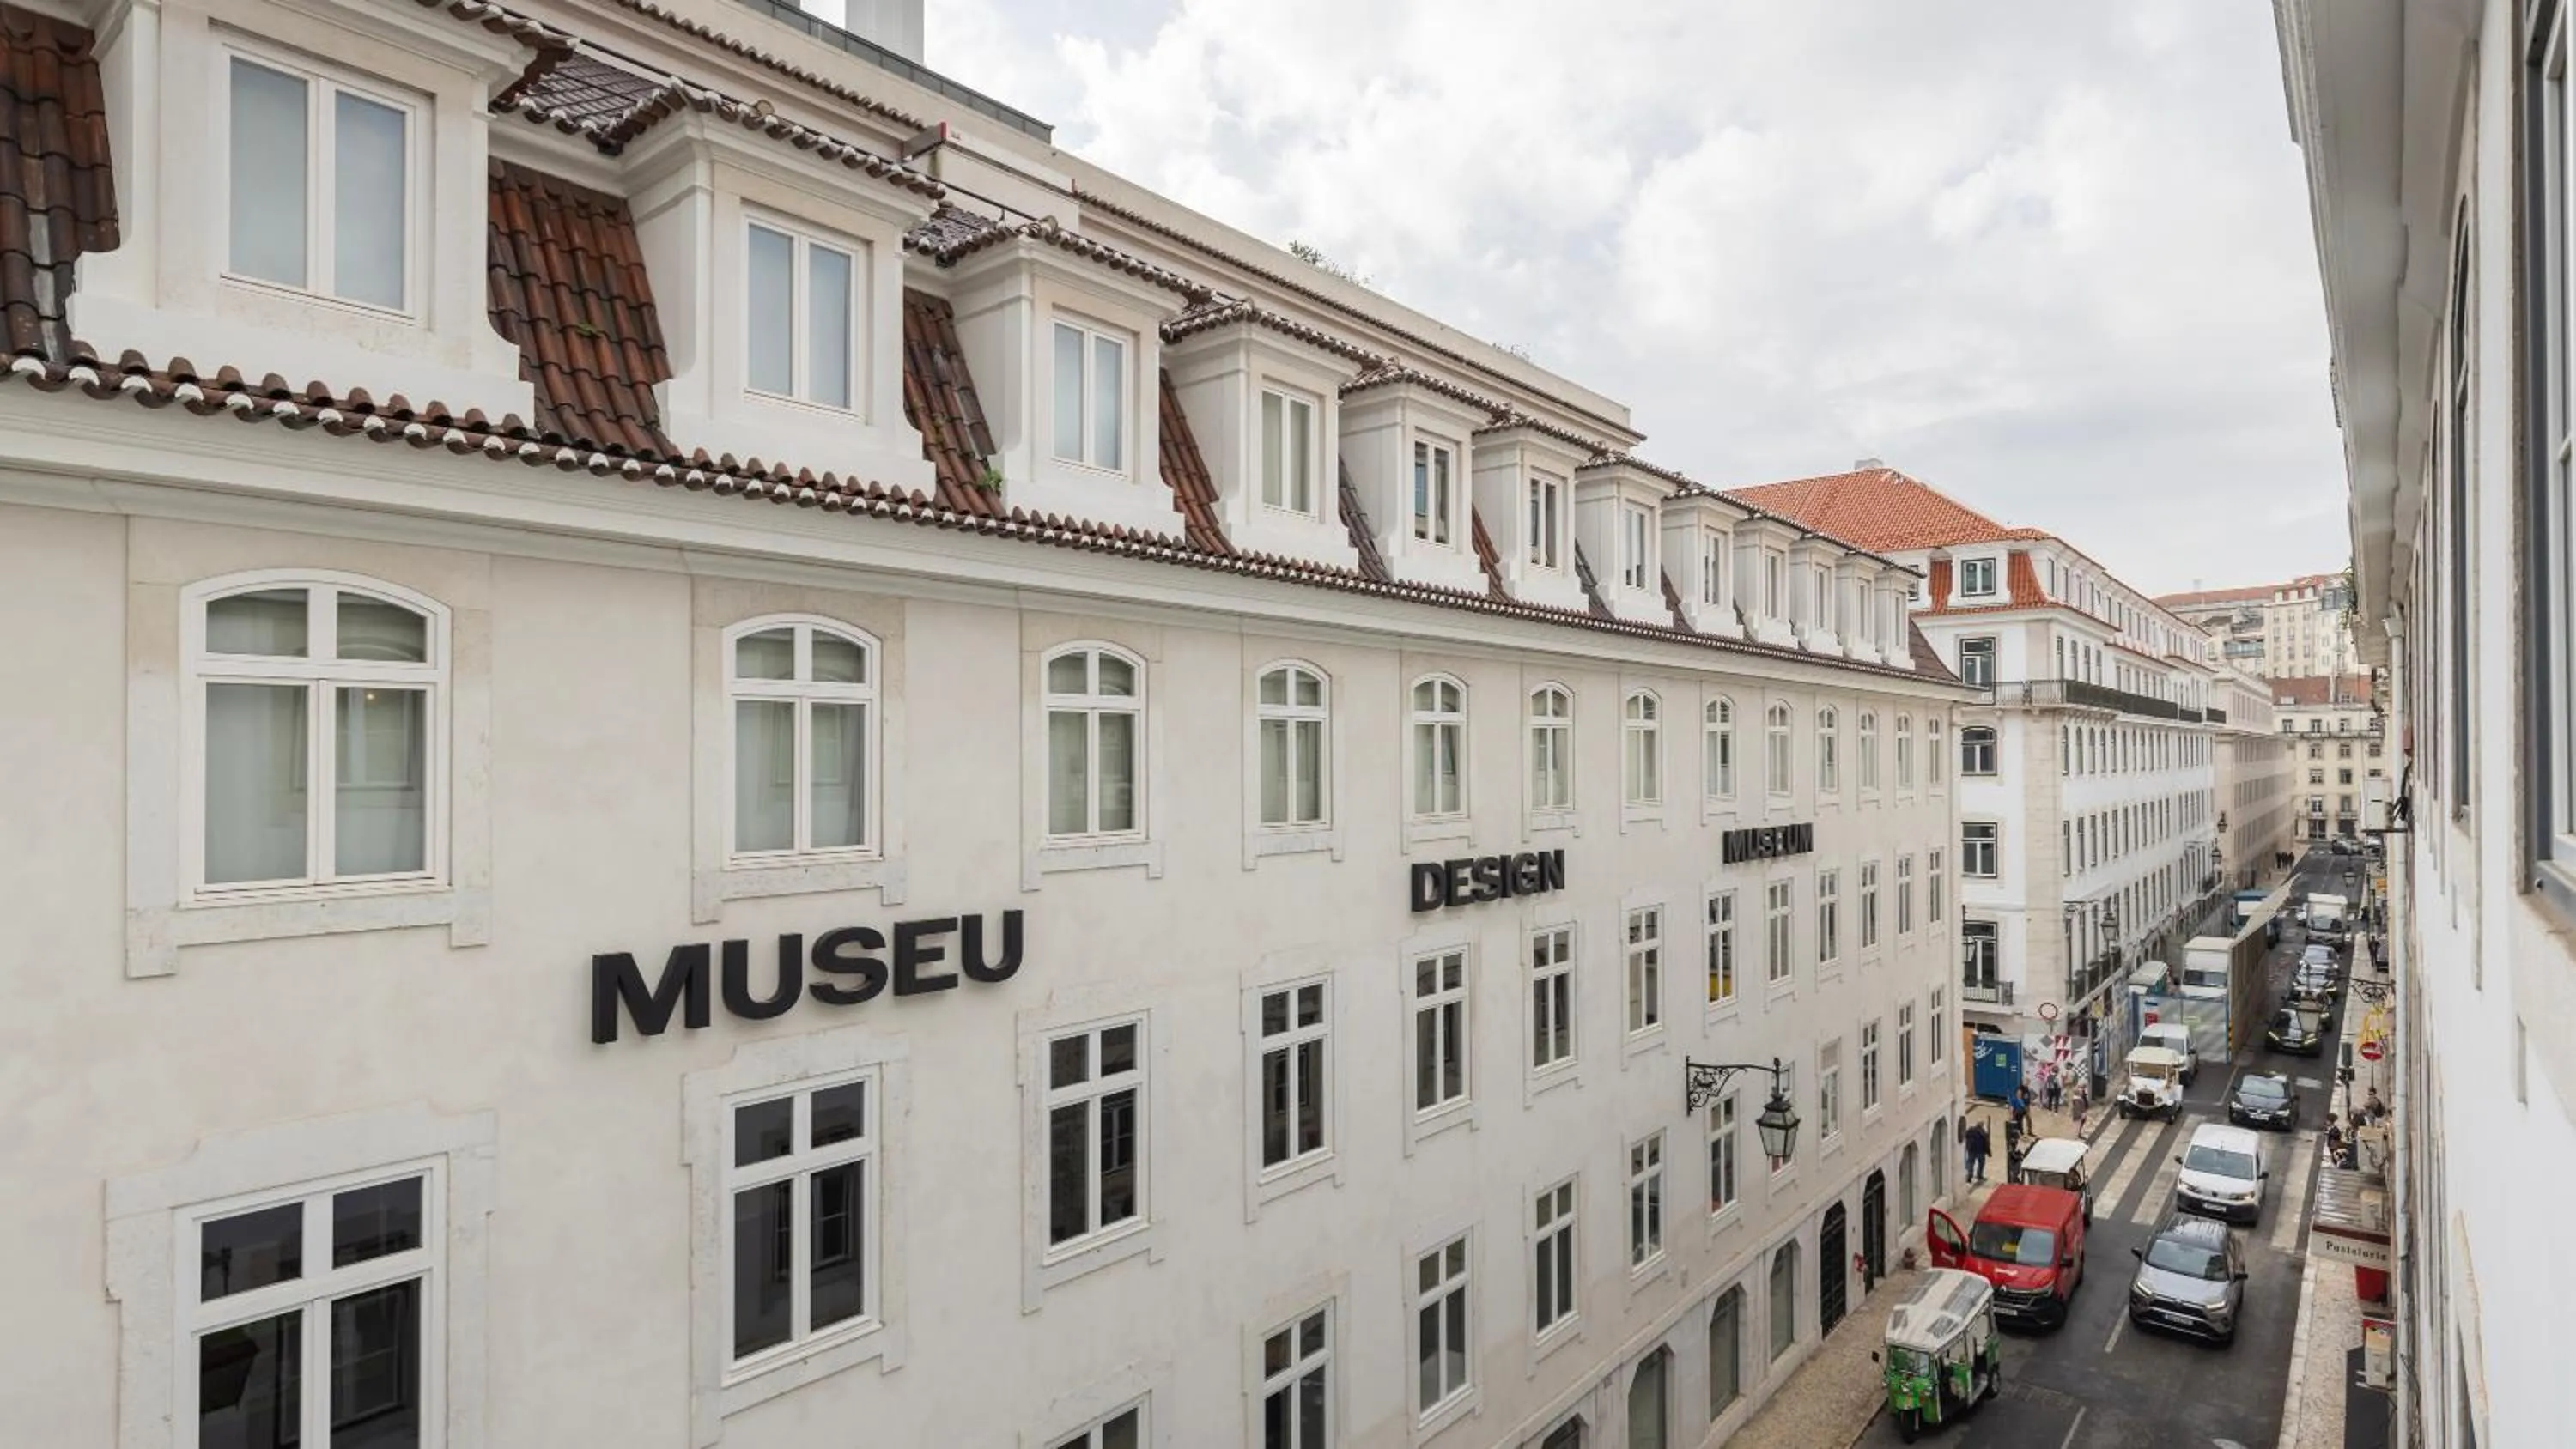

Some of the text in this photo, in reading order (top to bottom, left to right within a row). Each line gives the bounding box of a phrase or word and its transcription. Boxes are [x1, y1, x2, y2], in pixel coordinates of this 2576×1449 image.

[592, 822, 1814, 1044] MUSEU DESIGN MUSEUM
[2326, 1240, 2386, 1260] Pastelaria
